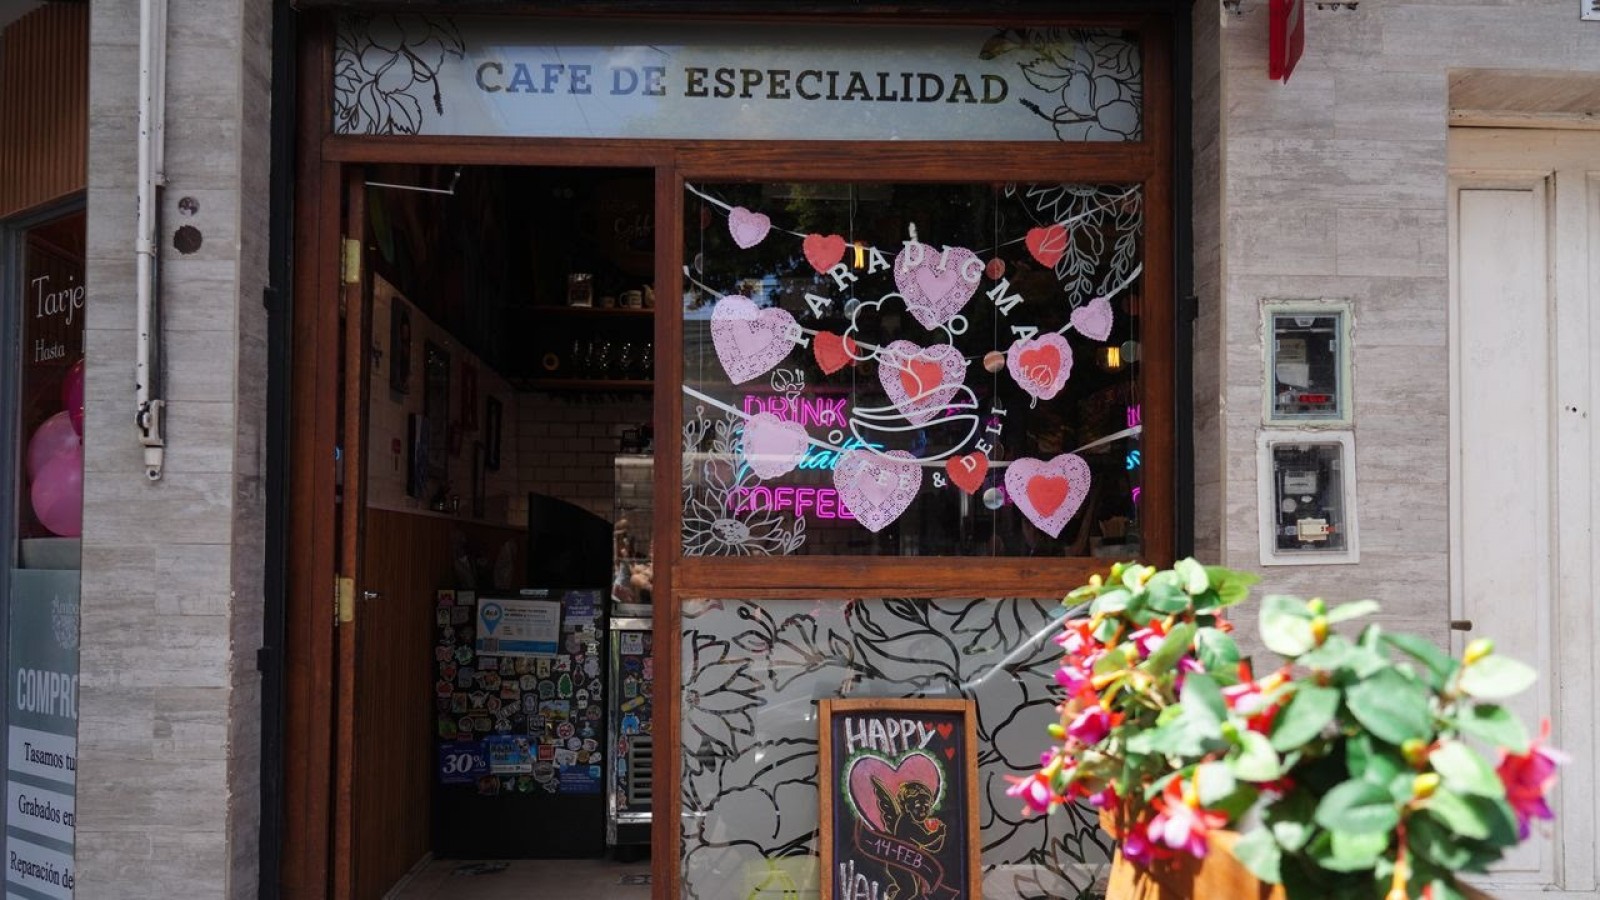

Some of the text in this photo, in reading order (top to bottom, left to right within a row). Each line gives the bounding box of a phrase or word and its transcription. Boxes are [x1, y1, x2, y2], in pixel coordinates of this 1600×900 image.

[475, 61, 1009, 105] CAFE DE ESPECIALIDAD
[31, 275, 85, 326] Tarje
[785, 240, 1040, 350] PARADIGMA
[35, 338, 65, 362] Hasta
[743, 394, 848, 428] DRINK
[931, 471, 948, 488] &
[959, 406, 1008, 473] DELI
[24, 742, 64, 769] Tasamos
[845, 716, 936, 757] HAPPY
[442, 753, 487, 774] 30%
[18, 794, 61, 825] Grabados
[10, 850, 74, 890] Reparación de
